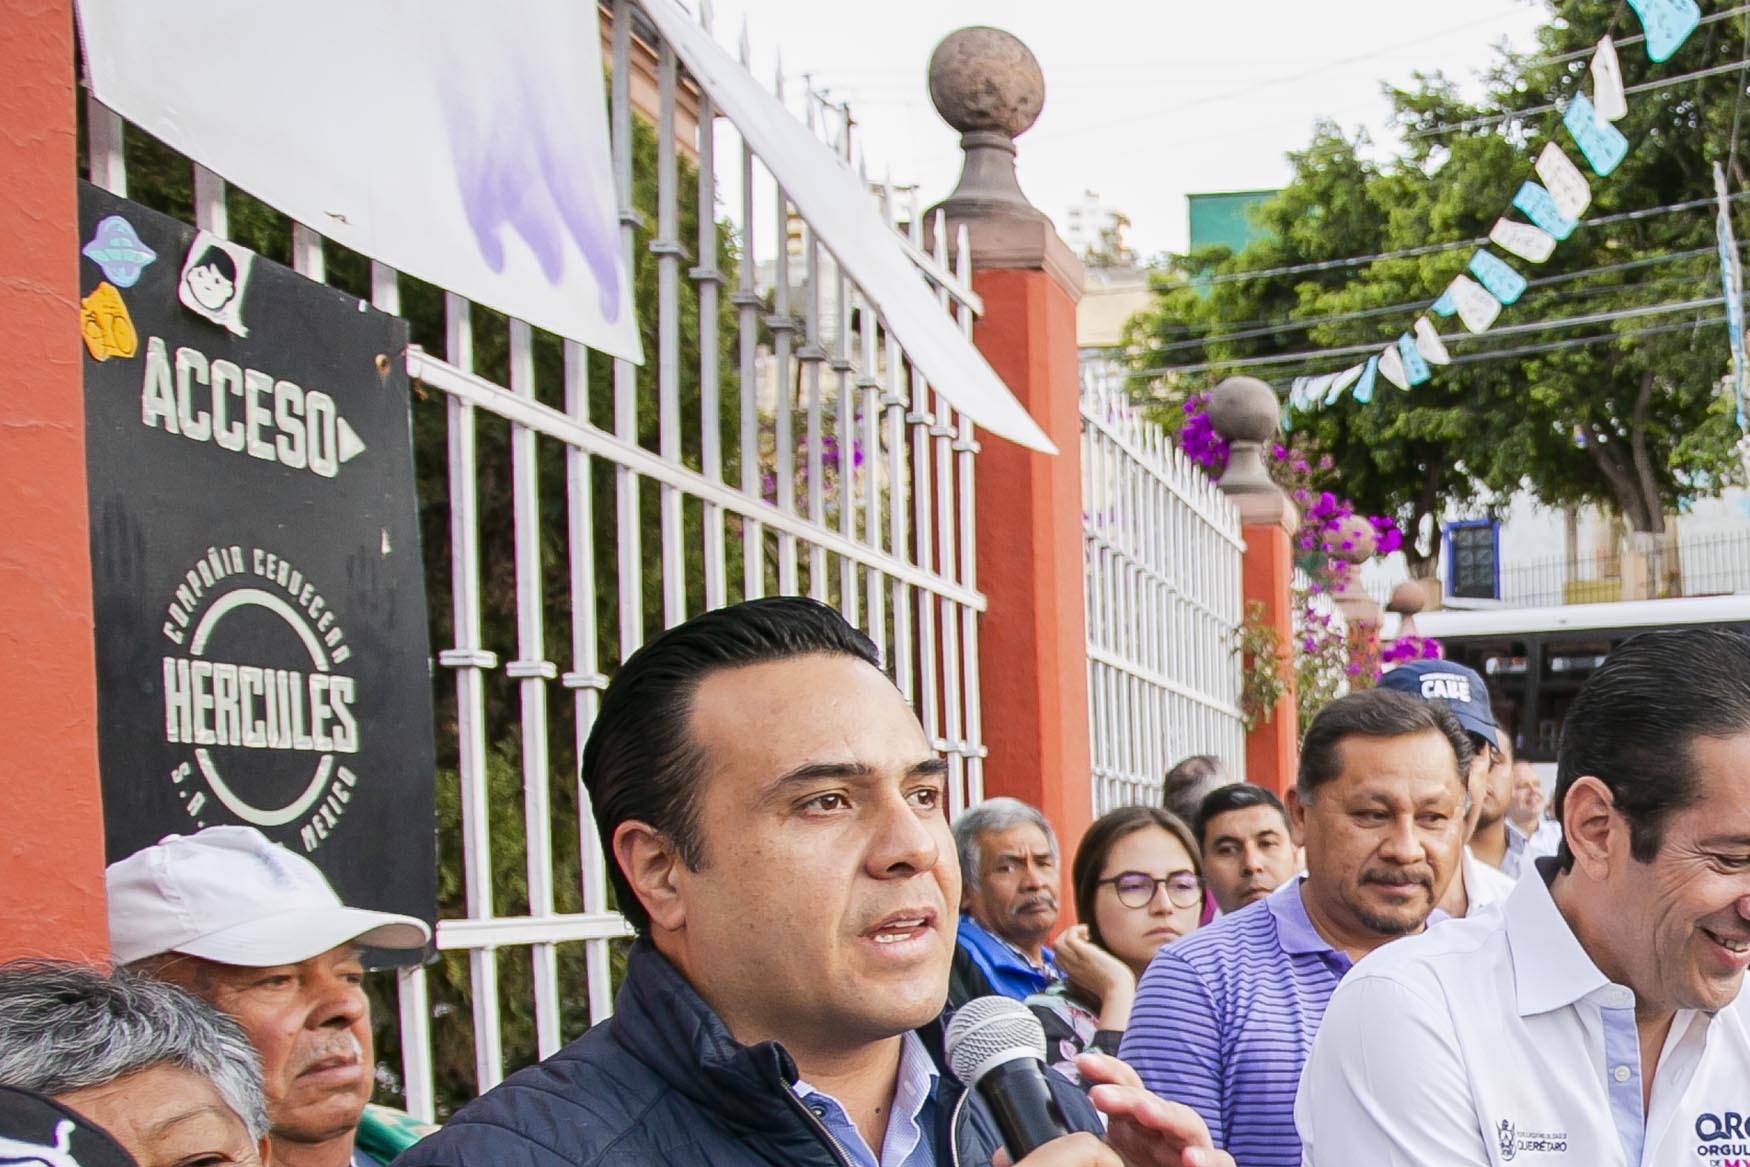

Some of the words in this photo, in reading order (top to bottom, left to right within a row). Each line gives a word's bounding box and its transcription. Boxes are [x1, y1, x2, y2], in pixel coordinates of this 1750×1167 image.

[142, 336, 338, 478] ACCESO
[253, 548, 351, 664] CERVECERA
[163, 656, 359, 753] HERCULES
[300, 765, 357, 852] MEXICO
